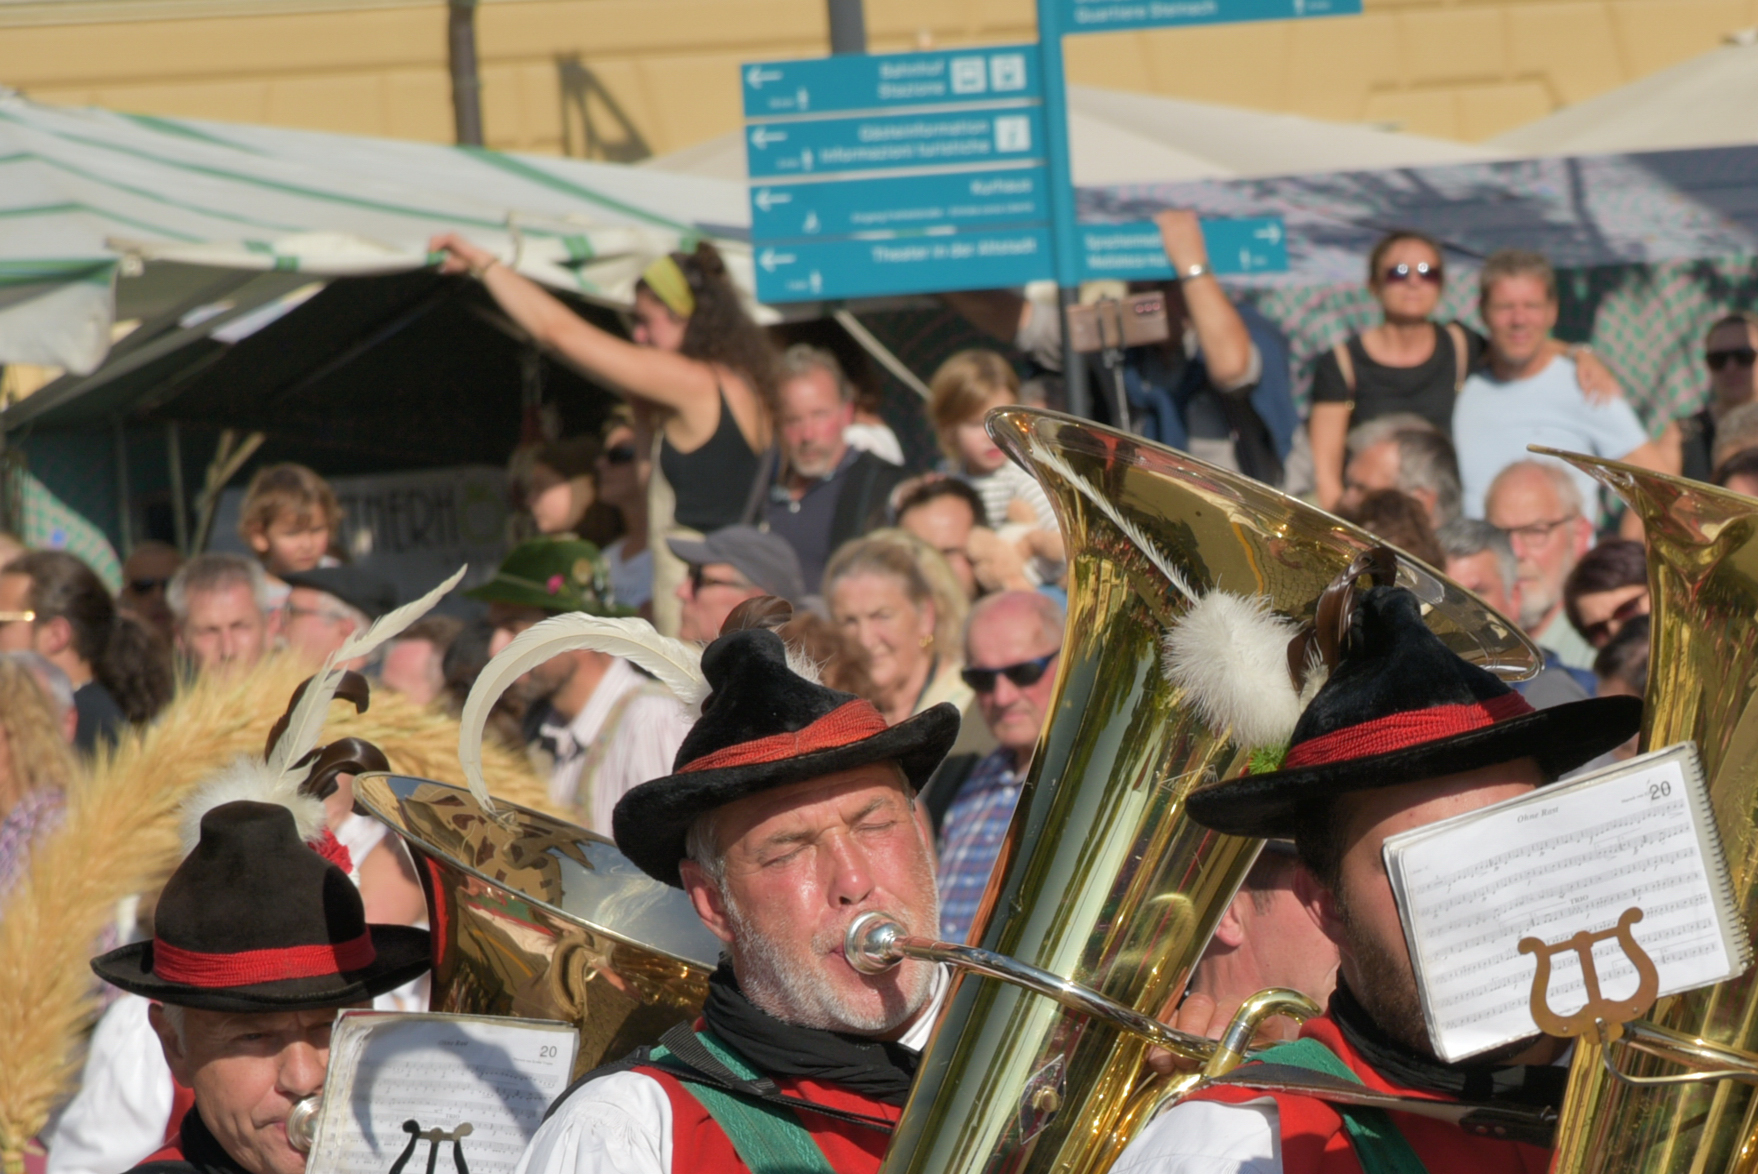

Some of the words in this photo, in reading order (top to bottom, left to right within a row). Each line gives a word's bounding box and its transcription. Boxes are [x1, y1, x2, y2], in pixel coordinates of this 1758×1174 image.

[879, 59, 944, 79] Bahnhof
[877, 80, 945, 99] Stazione
[872, 244, 930, 263] Theater
[1649, 780, 1671, 800] 20
[1516, 809, 1540, 824] Ohne
[540, 1044, 558, 1059] 20
